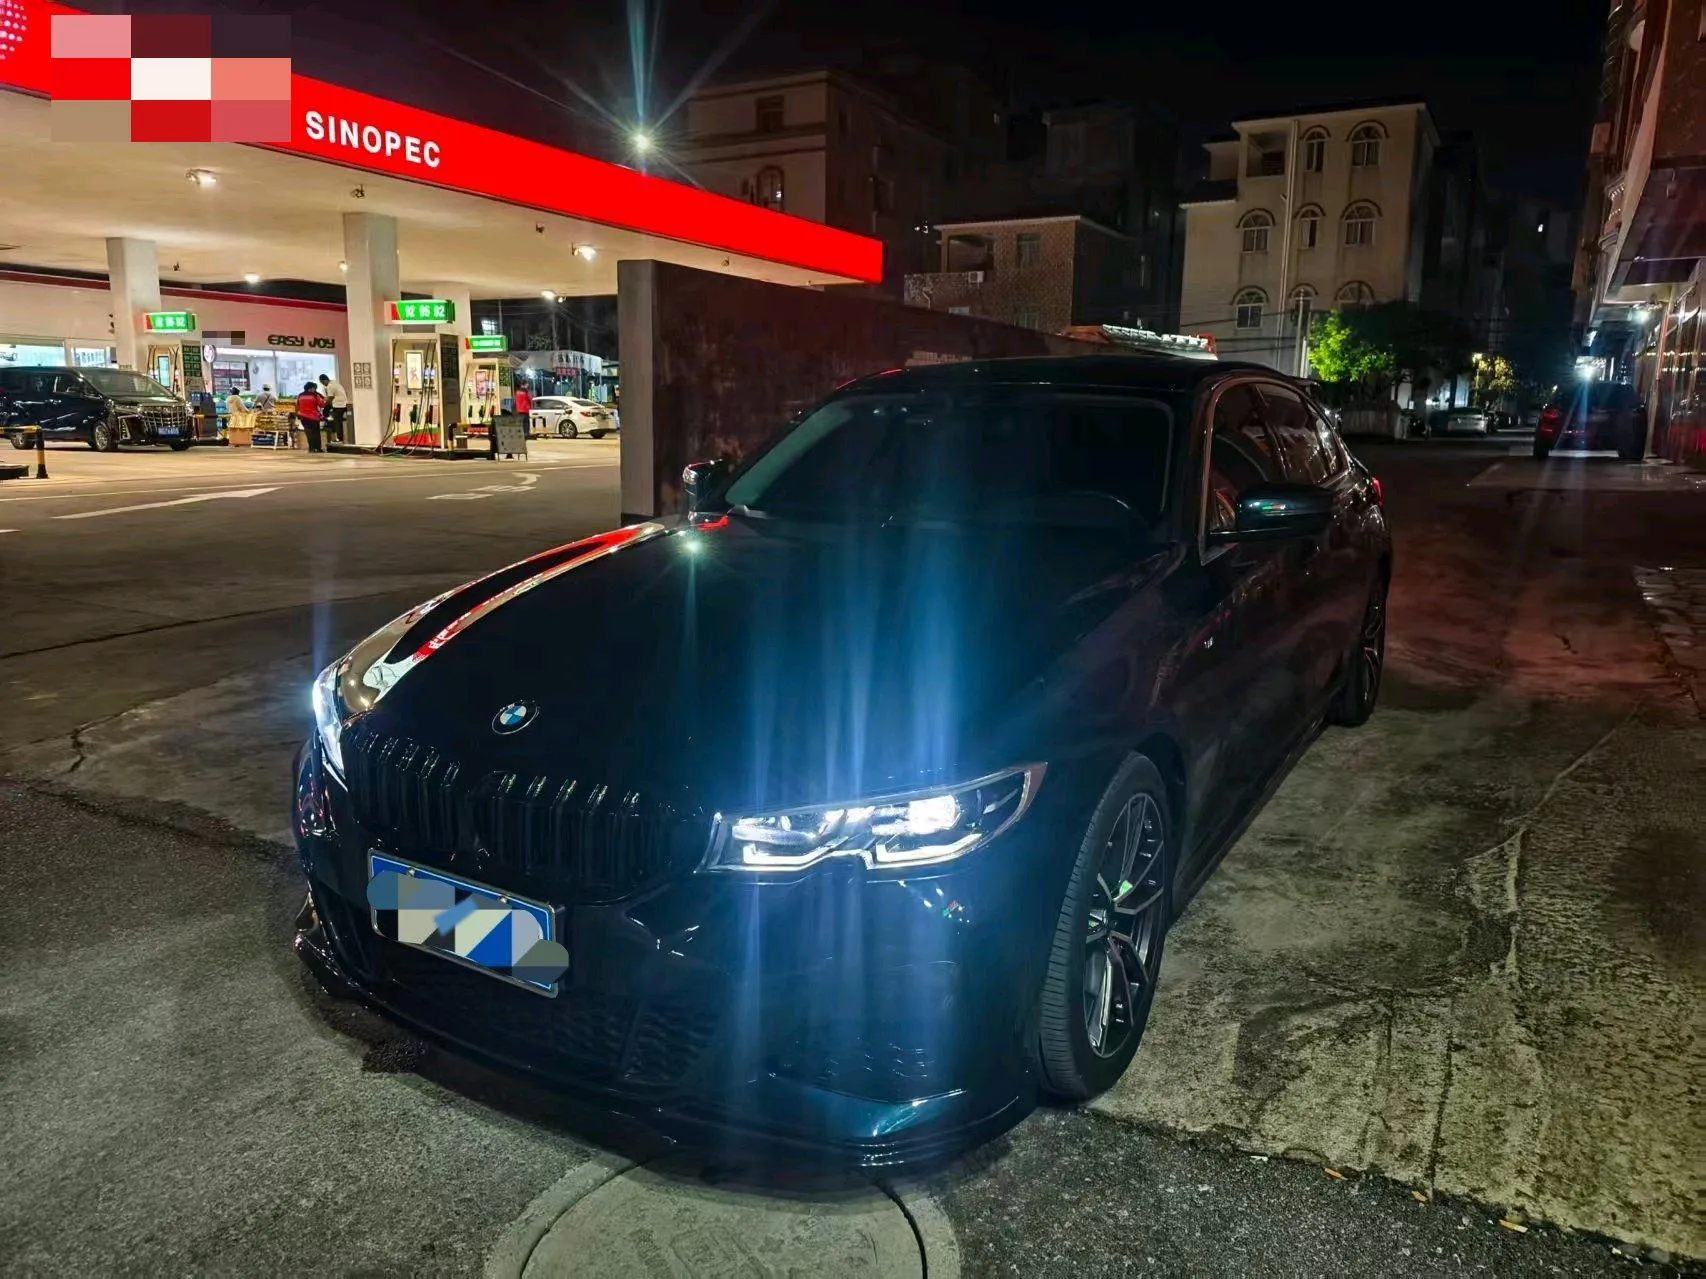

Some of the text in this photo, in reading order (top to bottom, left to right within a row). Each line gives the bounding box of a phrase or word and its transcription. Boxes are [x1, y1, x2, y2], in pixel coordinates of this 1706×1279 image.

[305, 110, 440, 168] SINOPEC
[268, 334, 335, 348] EASY JOY
